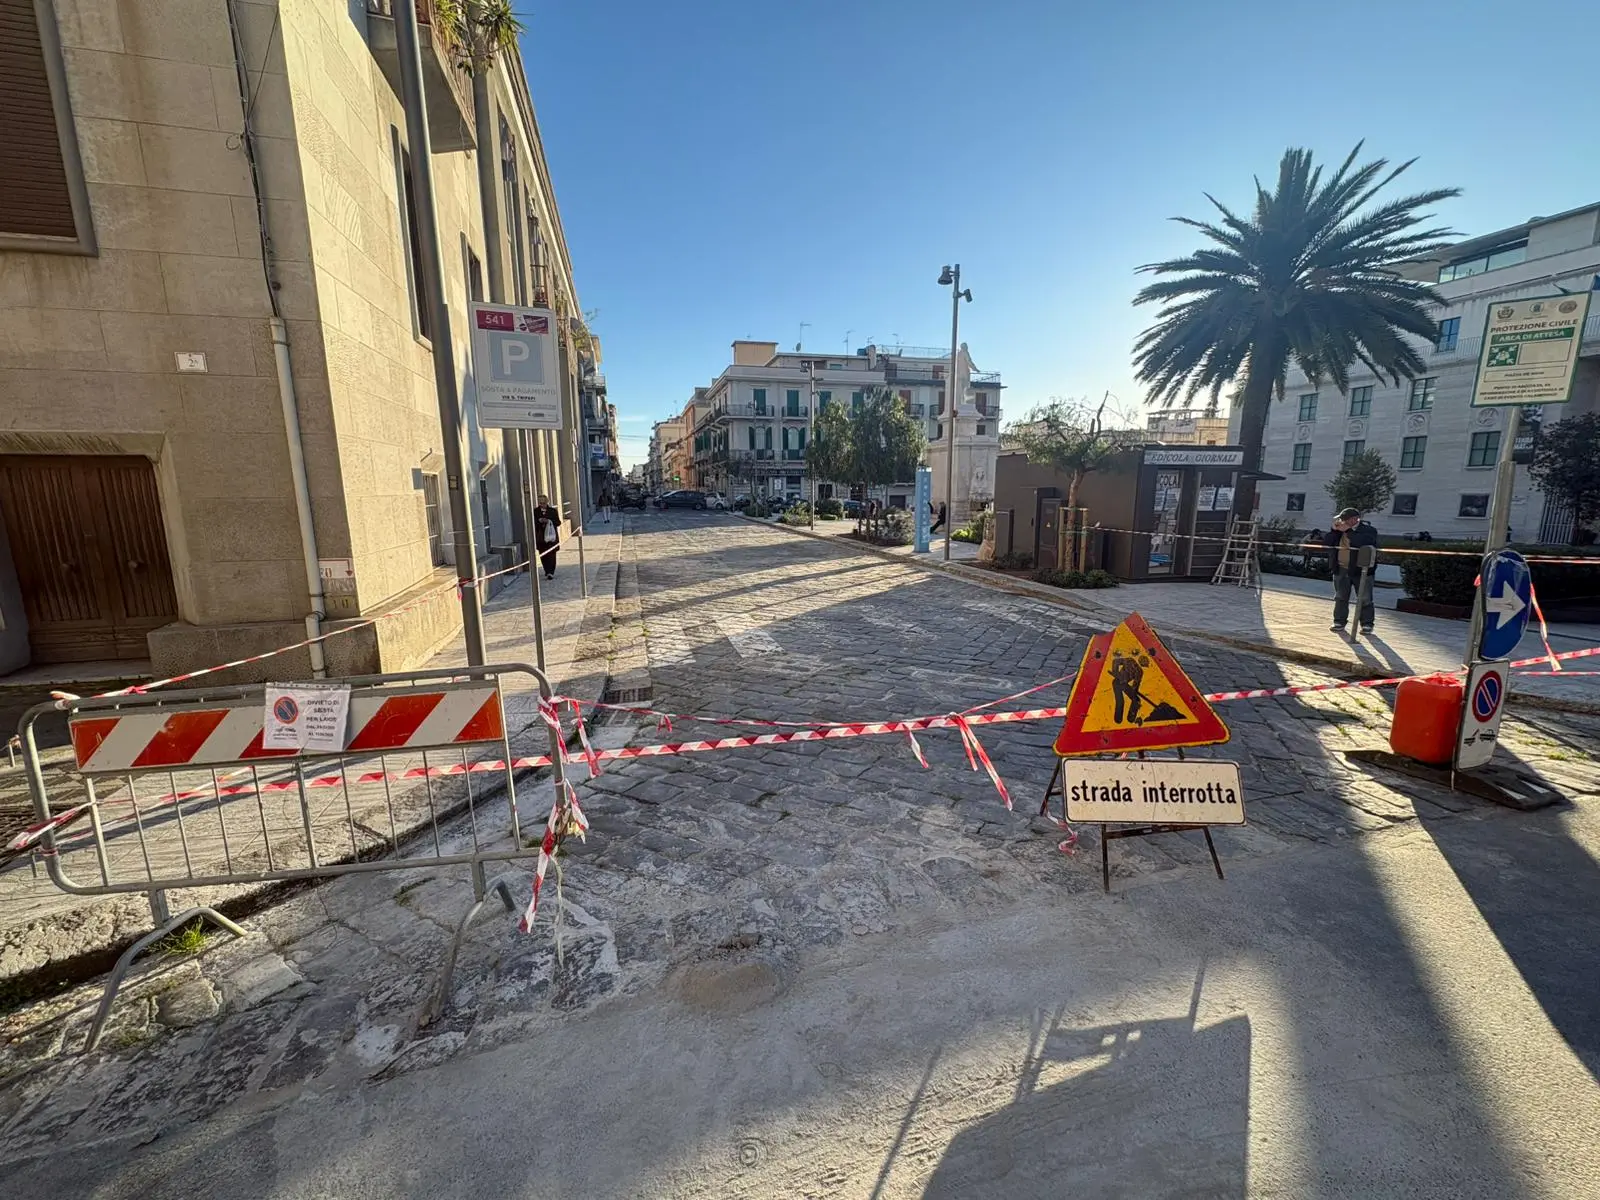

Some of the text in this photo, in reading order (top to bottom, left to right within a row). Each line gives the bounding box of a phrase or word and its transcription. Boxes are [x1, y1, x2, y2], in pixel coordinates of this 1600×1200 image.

[485, 314, 505, 325] 541
[1490, 318, 1579, 333] PROTEZIONE CIVILE
[1499, 334, 1521, 342] AREA
[1532, 330, 1565, 339] ATTESA
[501, 339, 530, 376] P
[512, 387, 556, 396] PAGAMENTO
[1151, 453, 1237, 463] EDICOLA GIORNALI
[1071, 780, 1237, 804] strada interrotta
